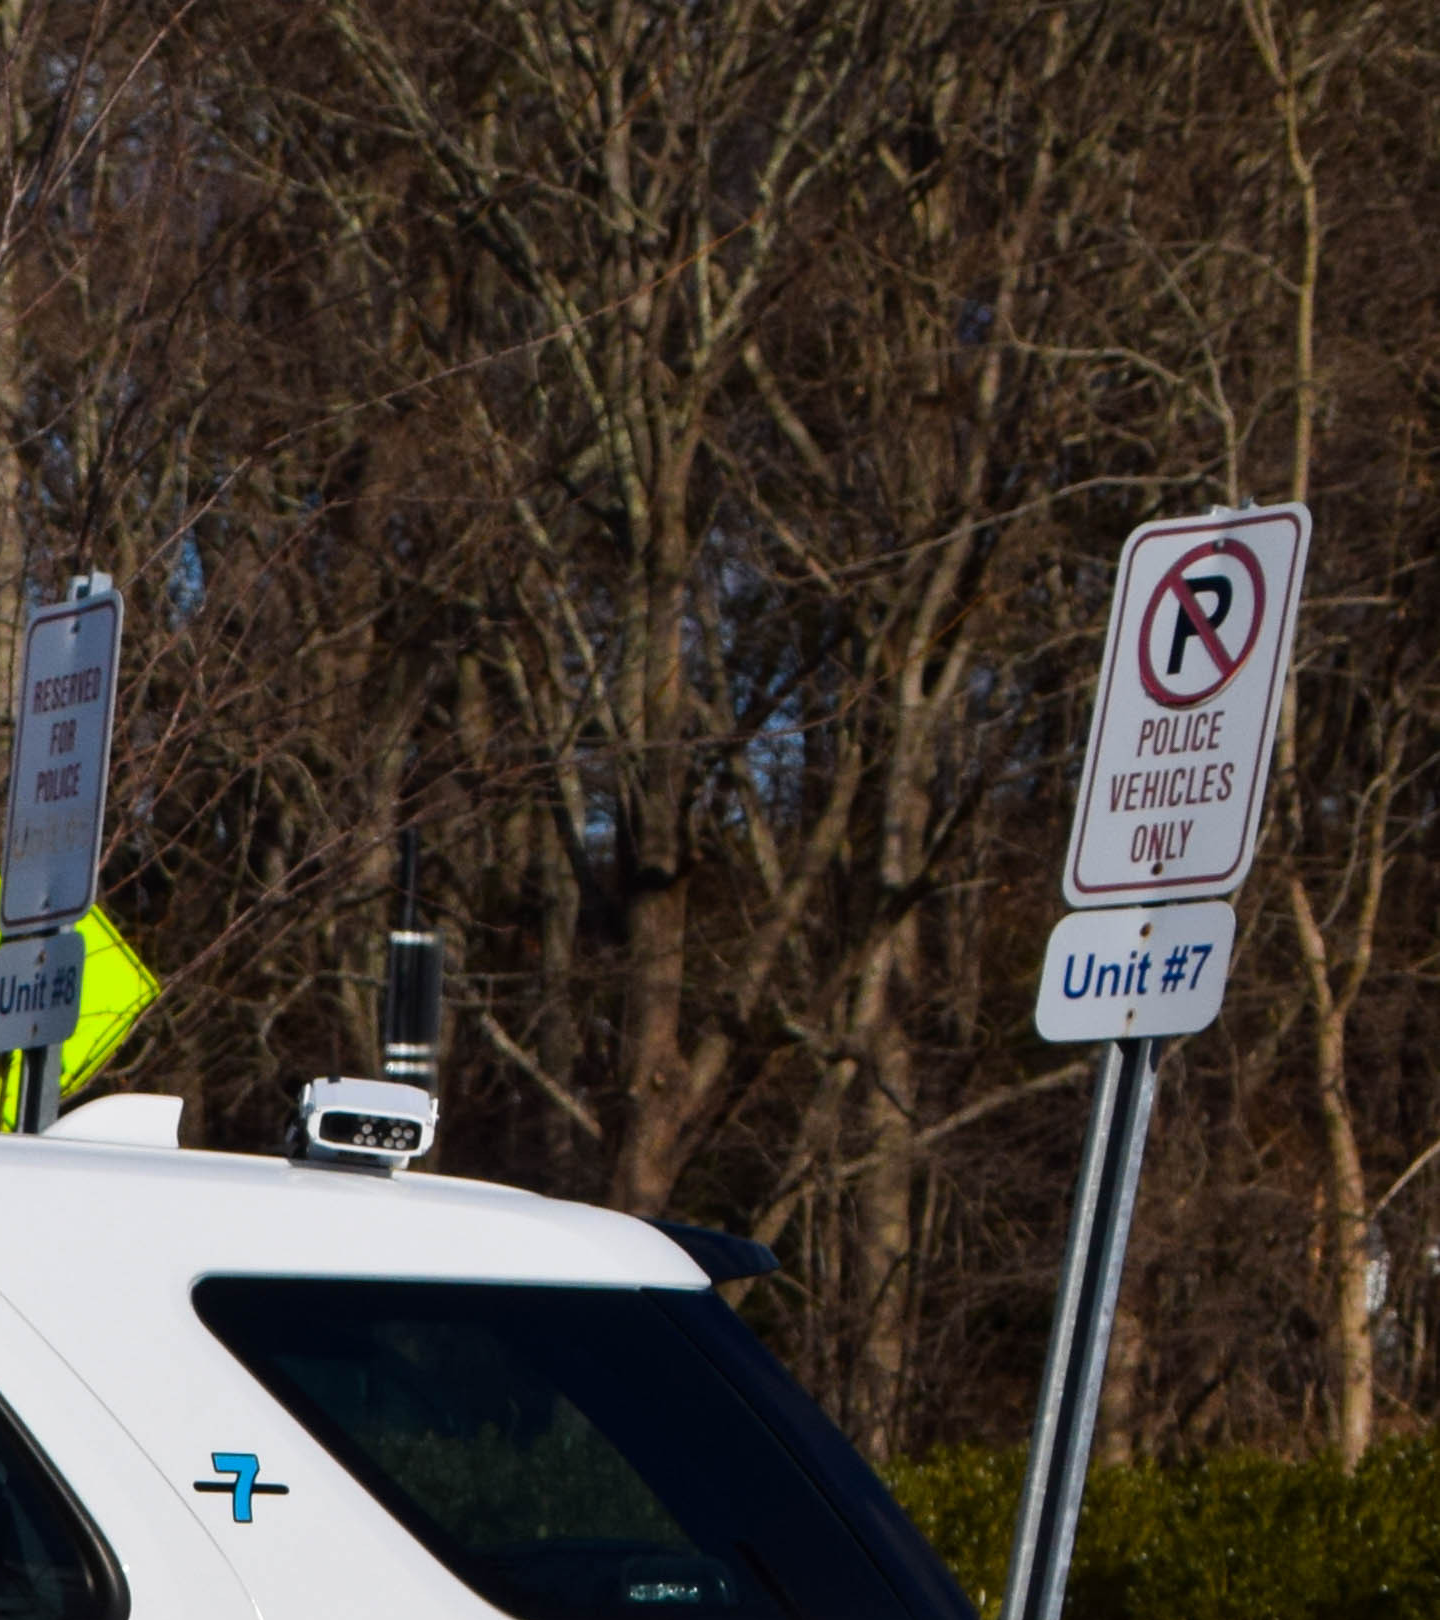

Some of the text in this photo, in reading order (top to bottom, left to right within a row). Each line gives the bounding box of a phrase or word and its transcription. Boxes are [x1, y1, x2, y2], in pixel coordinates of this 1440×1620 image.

[33, 666, 102, 715] RESERVED
[50, 719, 77, 757] FOR
[1136, 711, 1225, 757] POLICE
[35, 763, 82, 804] POLICE
[1109, 763, 1235, 812] VEHICLES
[1130, 820, 1194, 864] ONLY
[49, 966, 77, 1006] #8
[1063, 944, 1213, 999] Unit #7
[210, 1452, 260, 1524] 7
